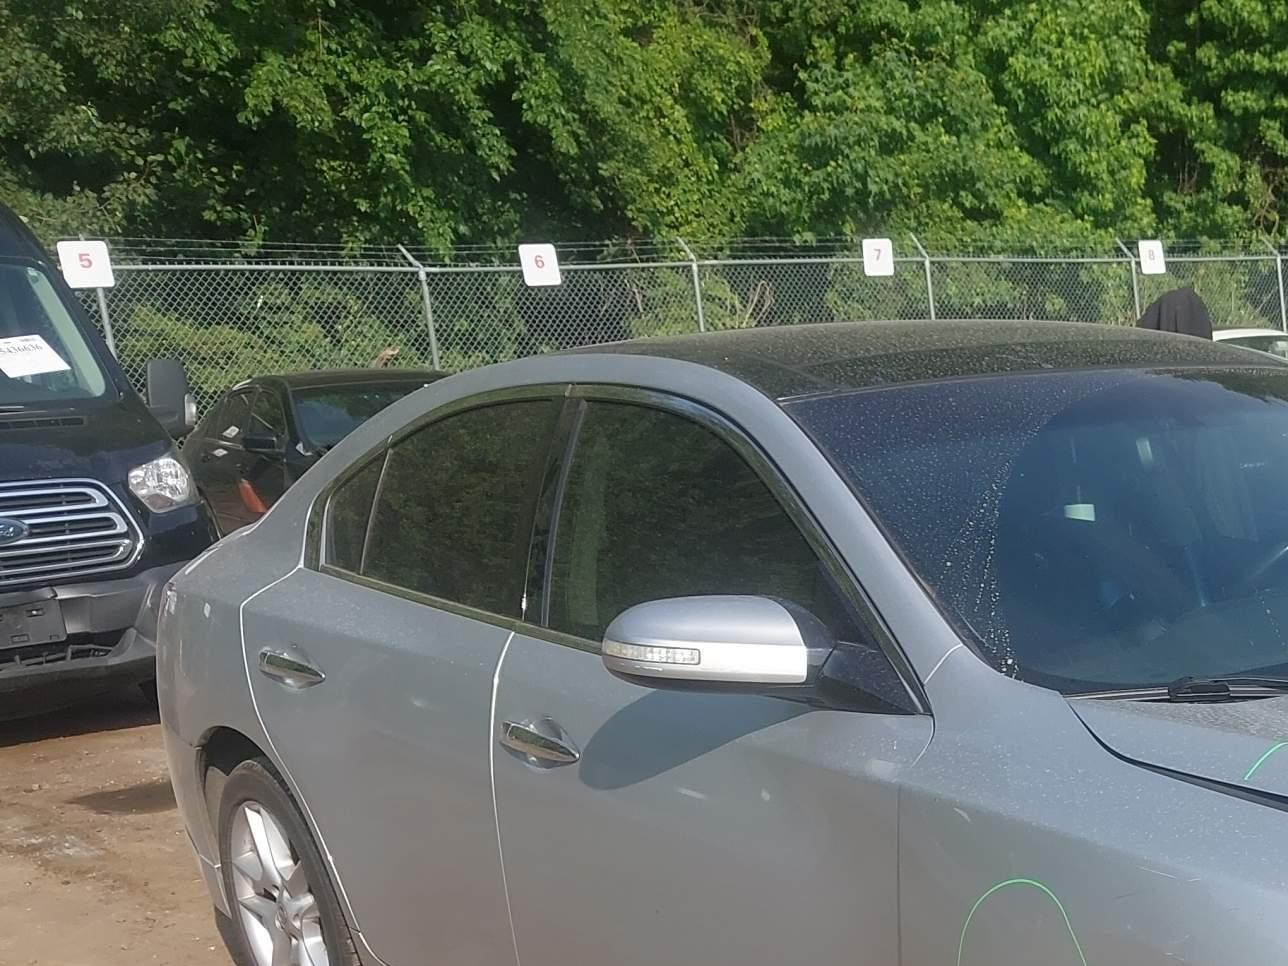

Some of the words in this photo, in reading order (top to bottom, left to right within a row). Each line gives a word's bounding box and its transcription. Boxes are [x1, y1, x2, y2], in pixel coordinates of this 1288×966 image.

[78, 253, 93, 269] 5
[534, 254, 545, 269] 6
[873, 247, 882, 261] 7
